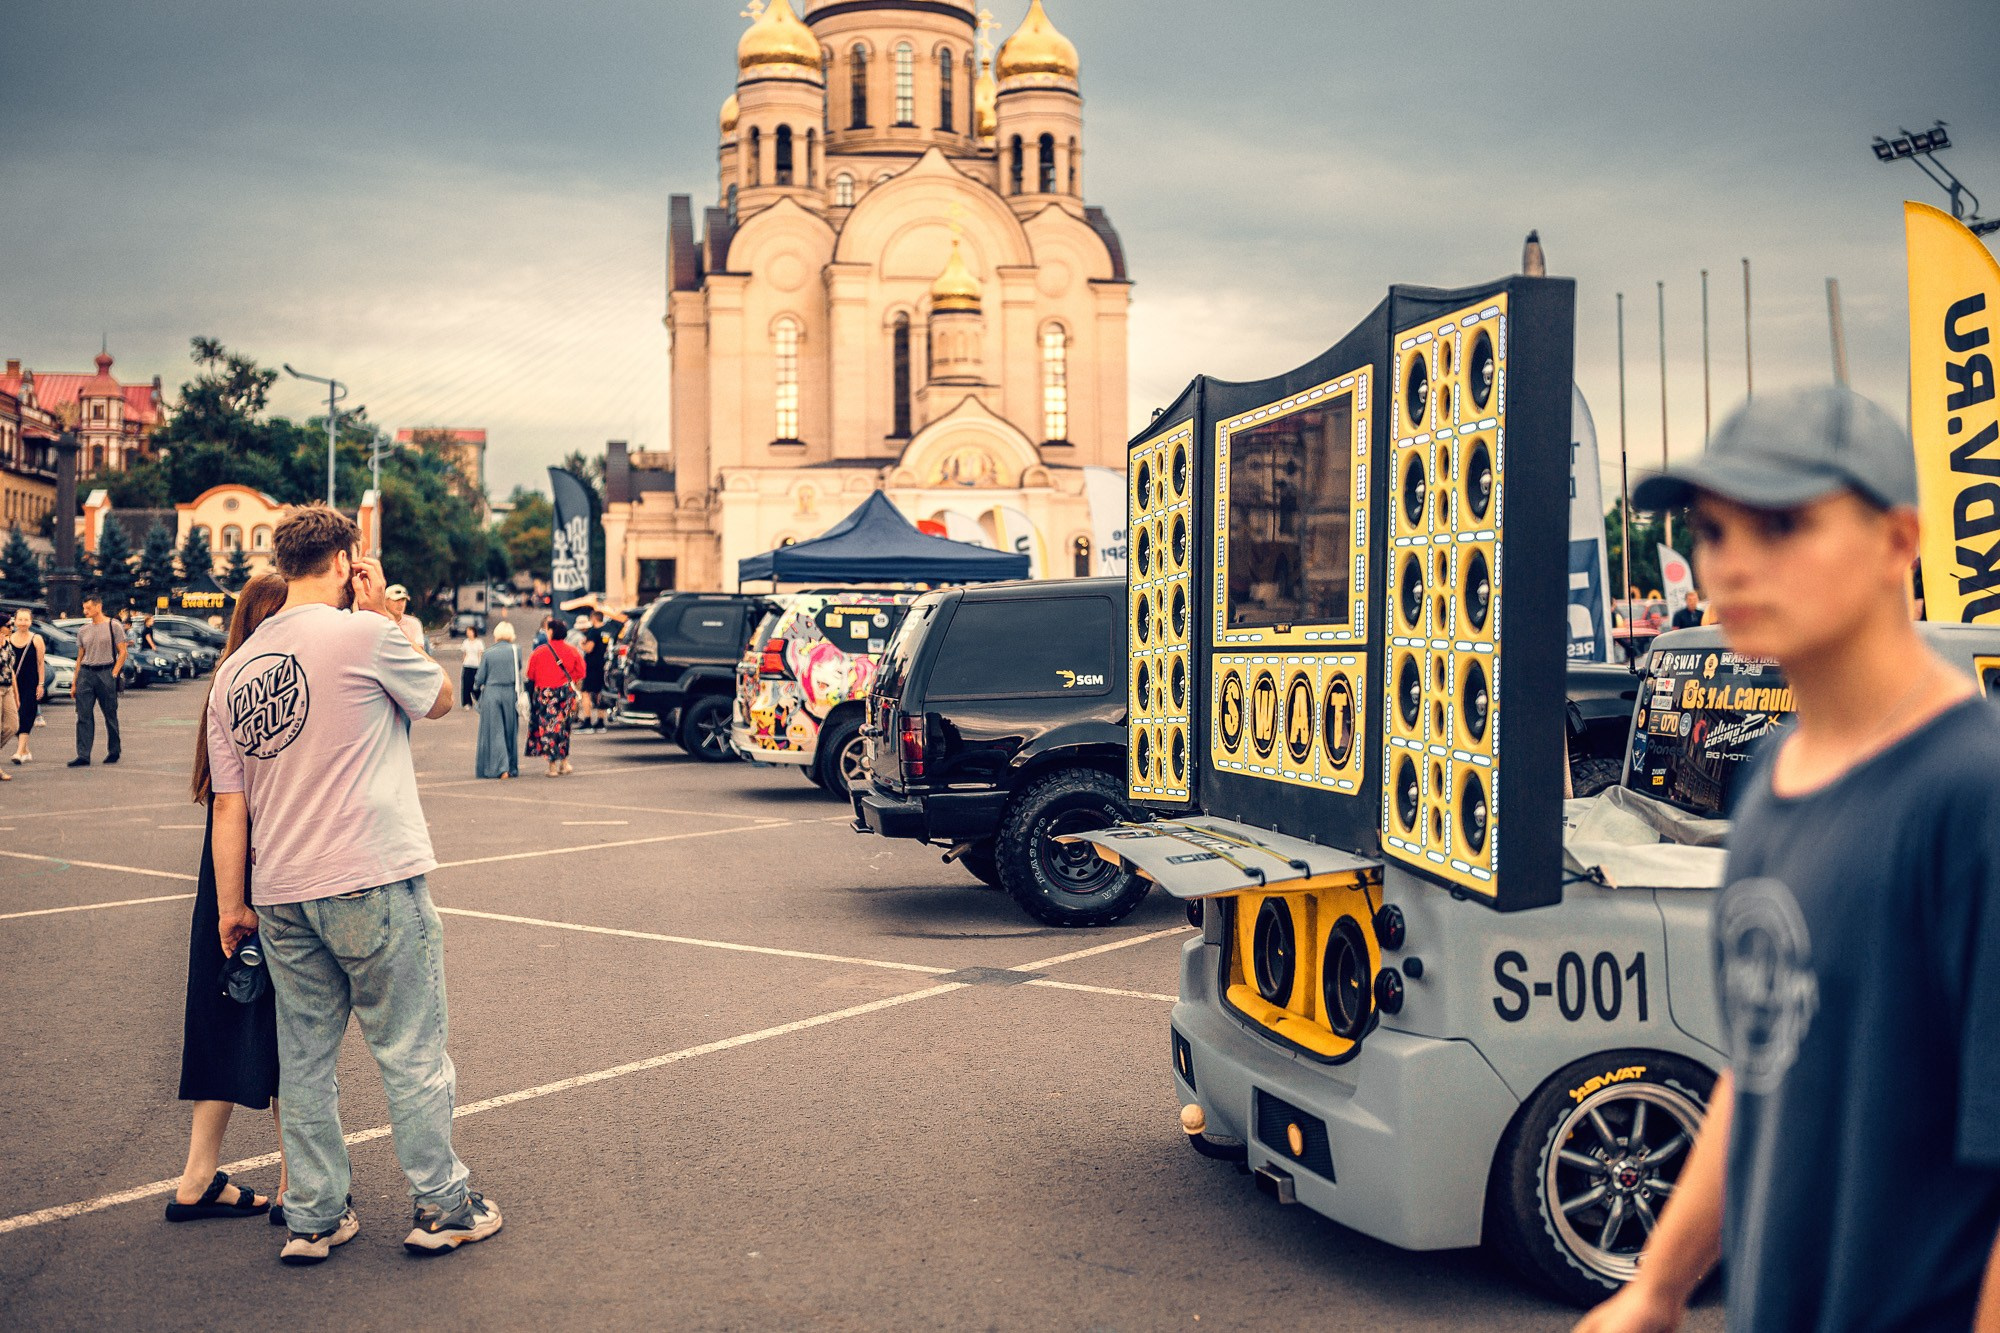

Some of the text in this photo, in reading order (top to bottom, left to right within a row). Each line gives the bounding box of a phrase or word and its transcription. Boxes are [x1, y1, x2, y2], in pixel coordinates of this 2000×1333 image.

[1673, 653, 1702, 671] SWAT
[1076, 674, 1104, 685] SGM
[1660, 713, 1678, 733] 070
[1493, 950, 1649, 1023] S-001
